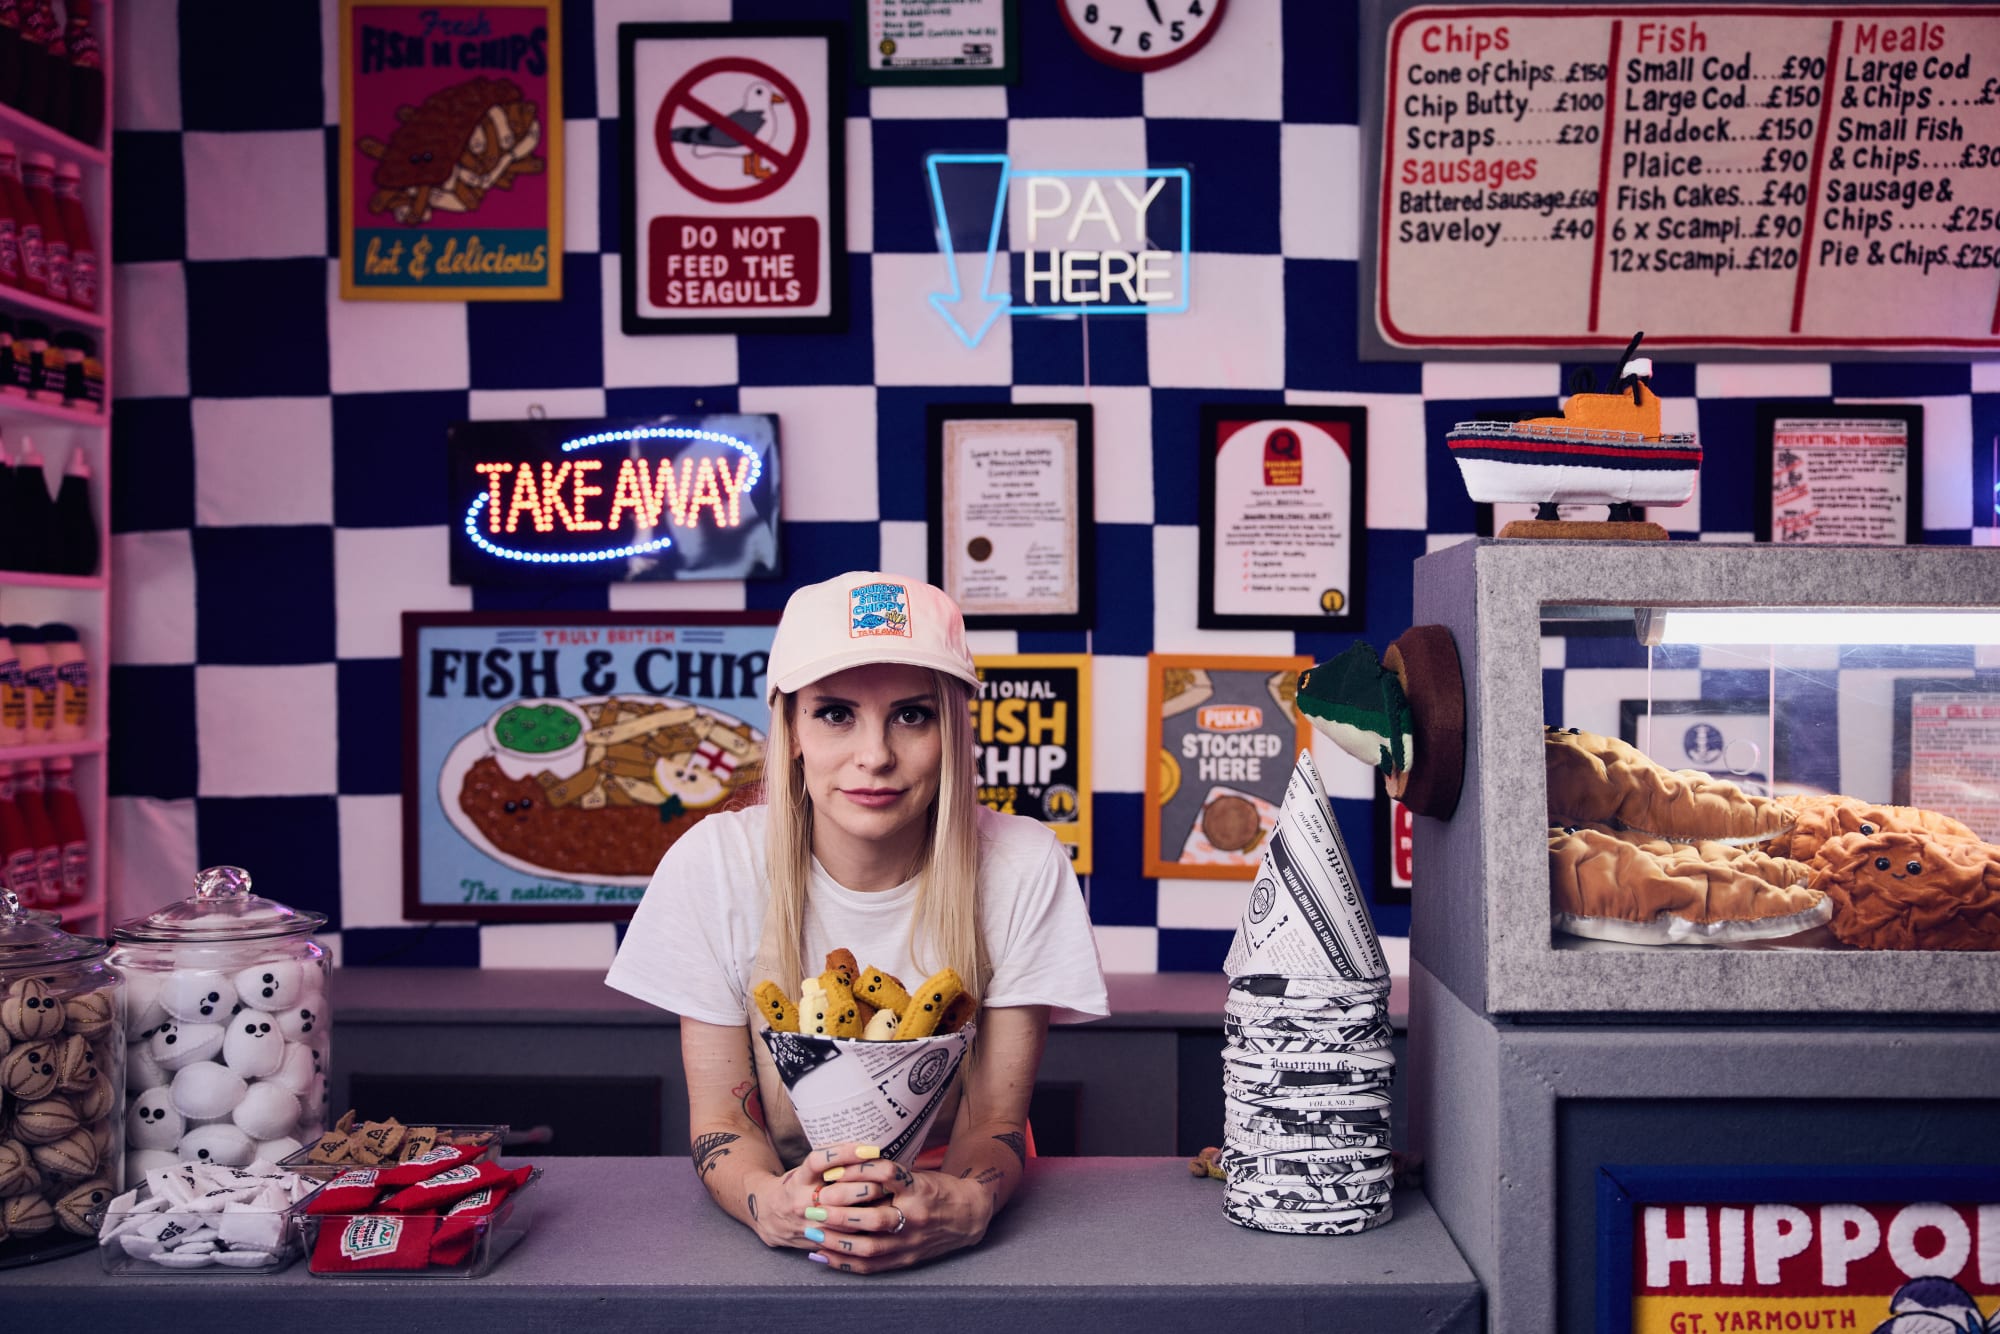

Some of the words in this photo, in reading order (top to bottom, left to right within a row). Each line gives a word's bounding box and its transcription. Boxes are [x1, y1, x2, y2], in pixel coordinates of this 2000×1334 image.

[420, 10, 491, 37] Fresh
[1085, 4, 1098, 24] 8
[1109, 26, 1123, 45] 7
[1138, 32, 1152, 51] 6
[1170, 21, 1184, 42] 5
[1421, 24, 1510, 61] Chips
[1637, 21, 1707, 53] Fish
[1855, 22, 1945, 54] Meals
[457, 26, 547, 76] CHIPS
[1407, 64, 1462, 85] Cone
[1467, 61, 1492, 86] of
[1494, 59, 1554, 90] Chips
[1565, 62, 1609, 83] £150
[1626, 56, 1694, 84] Small
[1702, 52, 1751, 80] Cod
[1781, 55, 1826, 80] £90
[1845, 56, 1917, 90] Large
[1923, 53, 1971, 80] Cod
[1404, 94, 1458, 124] Chip
[1466, 90, 1529, 122] Butty
[1553, 92, 1604, 112] £100
[1625, 87, 1697, 116] Large
[1702, 84, 1746, 108] Cod
[1766, 85, 1821, 108] £150
[1841, 85, 1858, 109] &
[1864, 83, 1932, 116] Chips
[1407, 124, 1495, 155] Scraps
[1556, 124, 1600, 144] £20
[1624, 116, 1730, 144] Haddock
[1757, 117, 1813, 141] £150
[1837, 116, 1908, 143] Small
[1915, 116, 1964, 141] Fish
[1623, 151, 1702, 178] Plaice
[1760, 148, 1808, 172] £90
[1829, 146, 1846, 171] &
[1852, 145, 1921, 176] Chips
[1026, 175, 1166, 243] PAY
[1400, 189, 1484, 214] Battered
[1617, 185, 1666, 210] Fish
[1673, 184, 1740, 207] Cakes
[1759, 180, 1808, 205] £40
[681, 226, 718, 249] DO
[732, 226, 786, 250] NOT
[1400, 217, 1501, 247] Saveloy
[1551, 218, 1595, 240] £40
[1612, 218, 1626, 241] 6
[1634, 221, 1650, 240] x
[1656, 216, 1741, 244] Scampi
[1754, 214, 1803, 238] £90
[1823, 207, 1893, 239] Chips
[365, 238, 401, 275] hot
[437, 236, 546, 275] delicious
[667, 255, 729, 278] FEED
[743, 255, 794, 278] THE
[1653, 248, 1736, 277] Scampi
[1743, 247, 1798, 270] £120
[1820, 240, 1859, 267] Pie
[1867, 241, 1885, 265] &
[1890, 240, 1949, 275] Chips
[1025, 246, 1175, 304] HERE
[666, 280, 801, 304] SEAGULLS
[475, 460, 602, 533] TAKE
[607, 457, 751, 529] AWAY
[852, 602, 905, 616] CHIPPY
[858, 593, 899, 606] STREET
[543, 630, 599, 645] TRULY
[607, 629, 676, 645] BRITISH
[857, 628, 906, 637] TAKEAWAY
[427, 647, 563, 699] FISH
[580, 648, 618, 696] &
[1205, 709, 1258, 727] PUKKA
[1181, 733, 1283, 758] STOCKED
[1199, 758, 1262, 781] HERE
[460, 878, 499, 904] The
[1282, 866, 1305, 897] FANFARE
[1325, 848, 1356, 907] Gazette
[1299, 895, 1320, 922] FRYING
[1313, 918, 1325, 932] TO
[1320, 930, 1339, 956] DOORS
[1335, 955, 1348, 969] ITS
[1670, 1312, 1707, 1334] GT.
[1714, 1308, 1857, 1333] YARMOUTH
